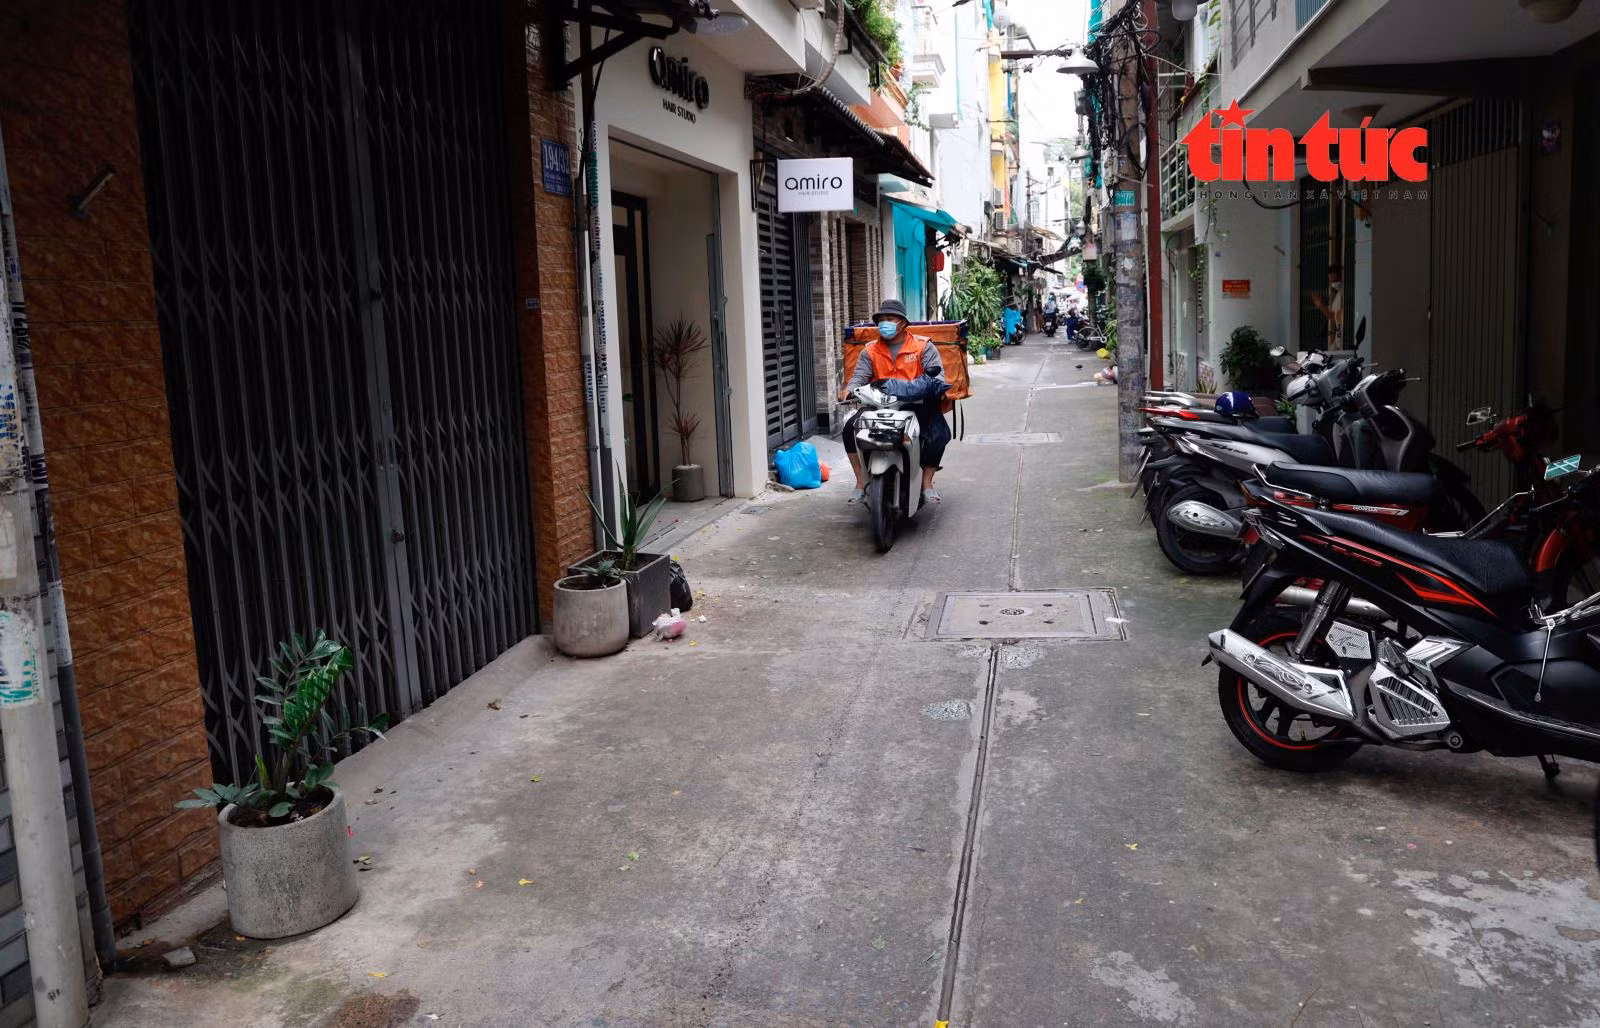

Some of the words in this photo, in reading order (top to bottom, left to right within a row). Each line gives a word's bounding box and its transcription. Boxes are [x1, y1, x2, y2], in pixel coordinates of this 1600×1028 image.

[662, 98, 679, 115] HAIR
[679, 106, 697, 124] STUDIO
[785, 174, 843, 190] amiro
